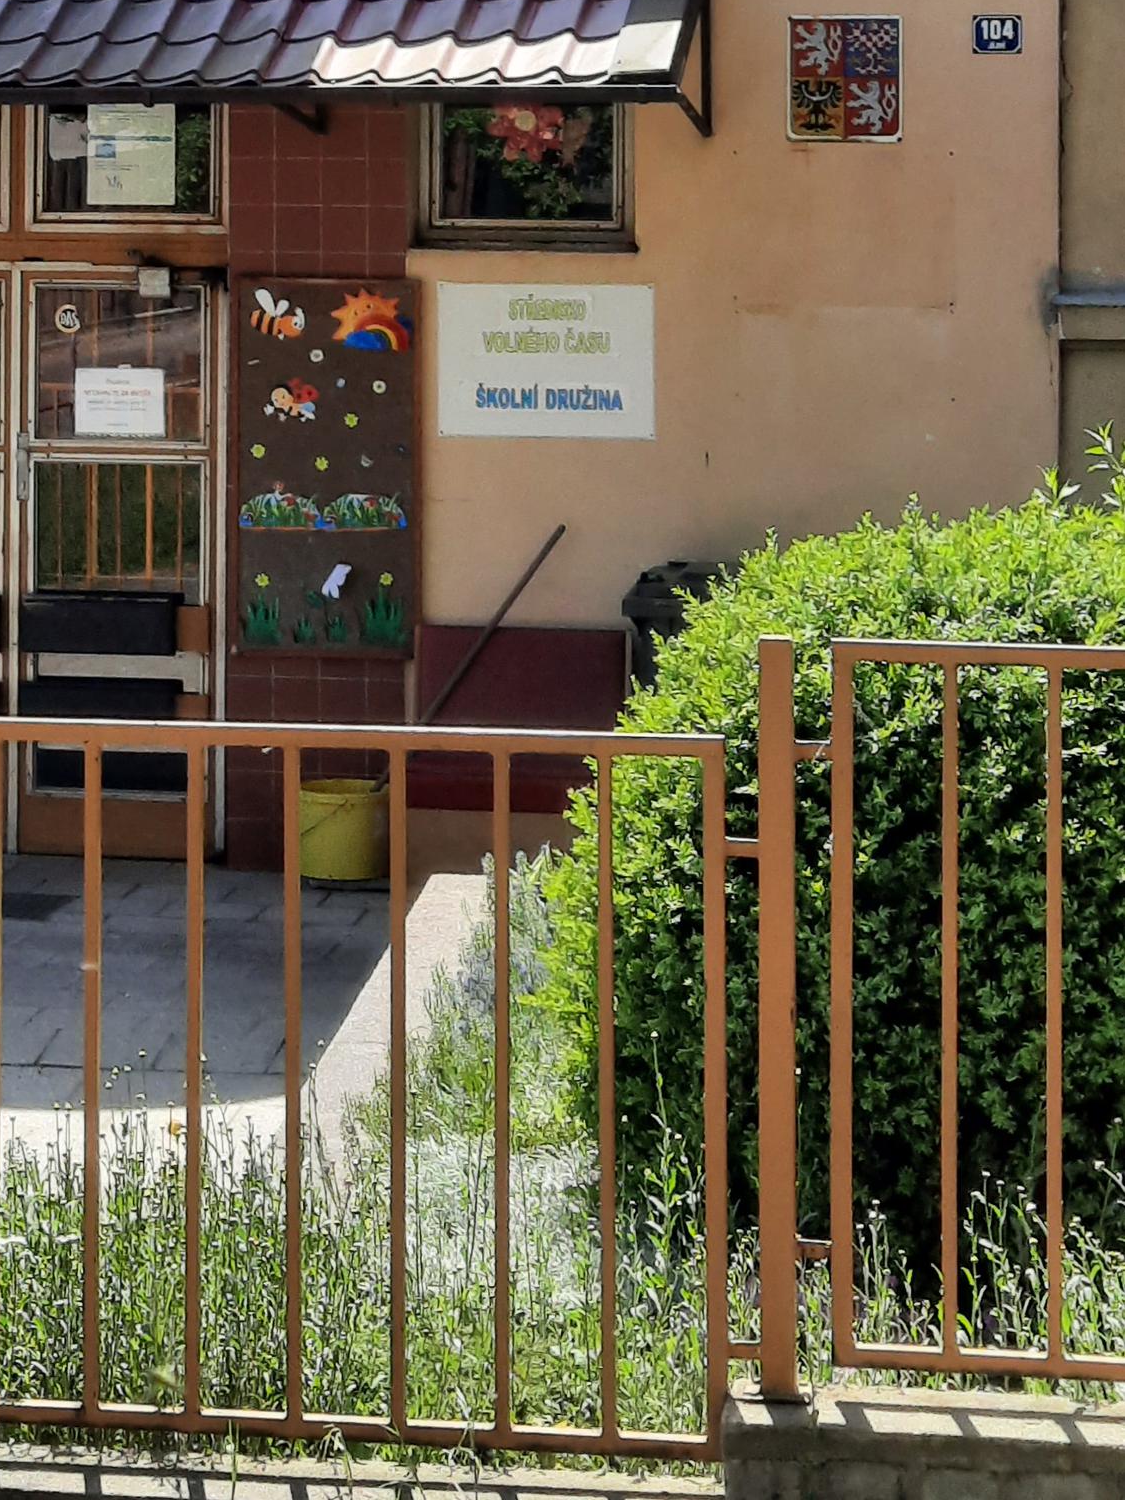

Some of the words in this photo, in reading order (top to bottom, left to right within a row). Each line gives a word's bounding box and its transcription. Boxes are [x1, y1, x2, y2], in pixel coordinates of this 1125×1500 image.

[980, 19, 1015, 40] 104
[508, 293, 587, 321] STŘEDISKO
[482, 326, 561, 354] VOLNÉHO
[563, 327, 611, 354] ČASU
[475, 383, 539, 410] ŠKOLNÍ
[545, 384, 624, 412] DRUŽINA
